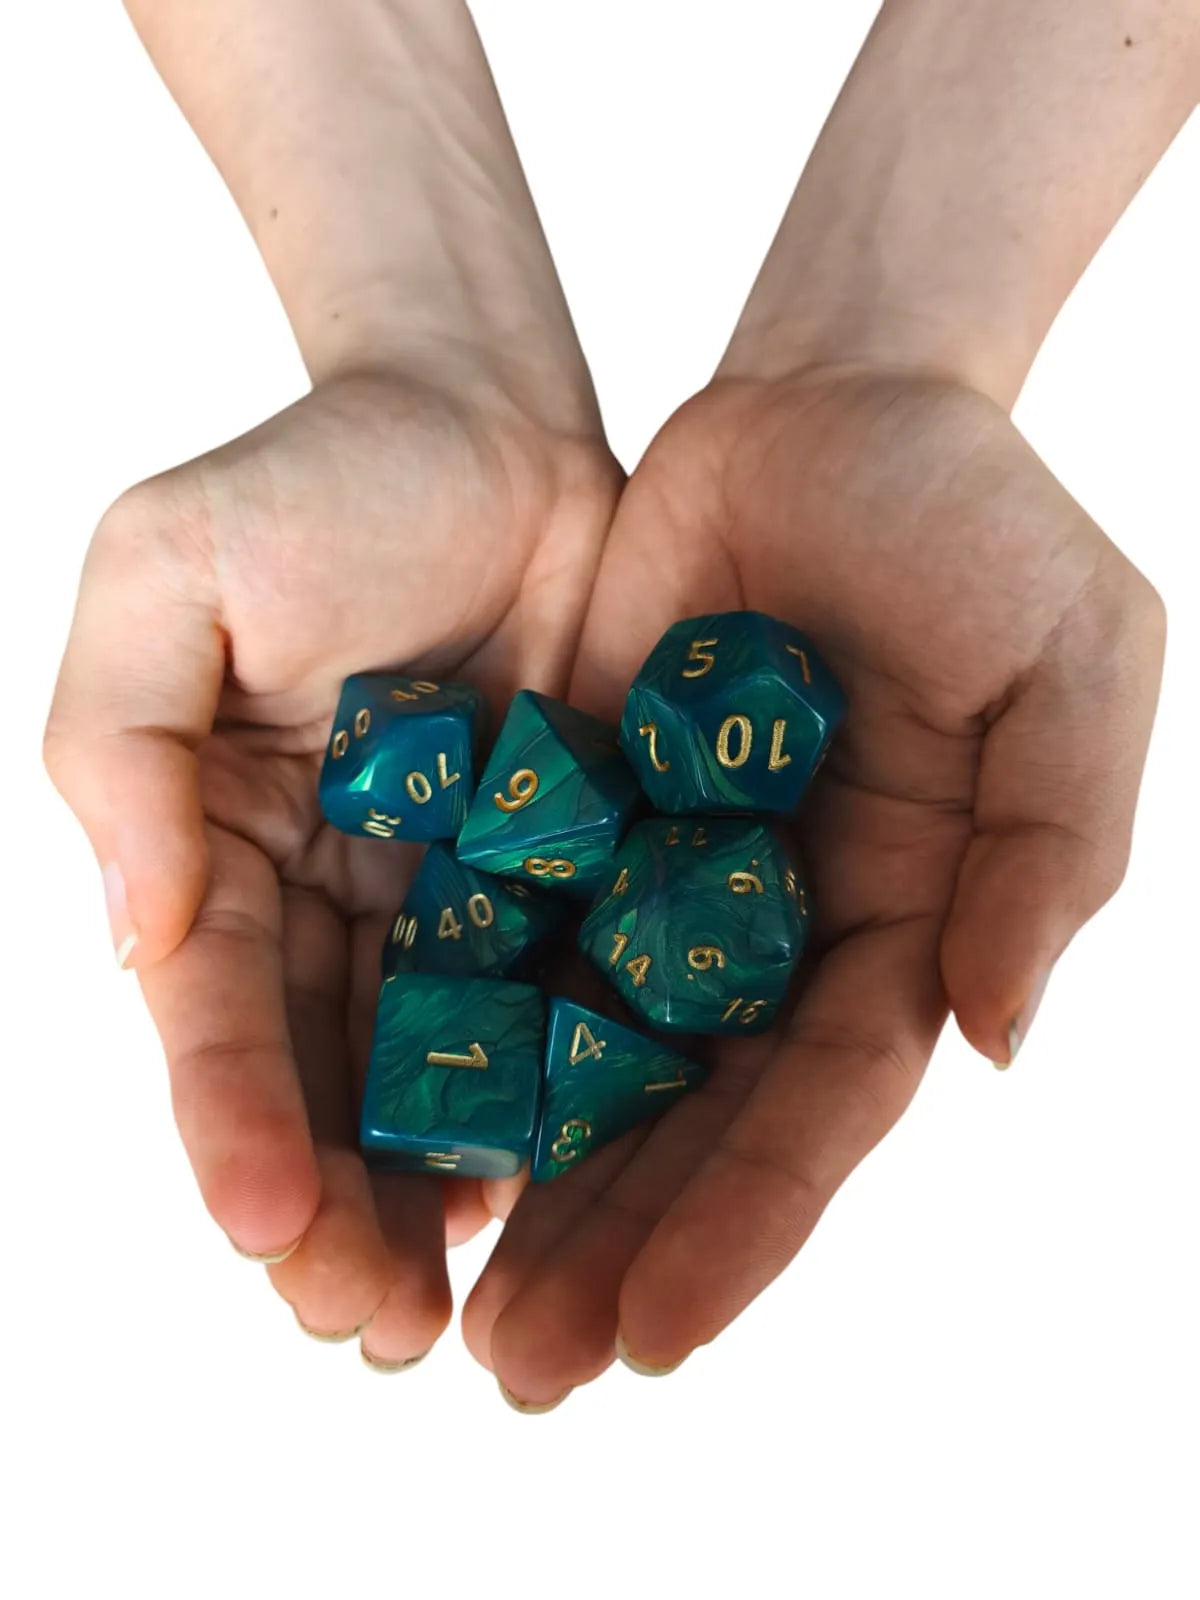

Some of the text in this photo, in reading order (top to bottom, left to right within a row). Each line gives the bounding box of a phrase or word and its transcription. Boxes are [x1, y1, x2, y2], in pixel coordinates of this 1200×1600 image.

[681, 637, 719, 678] 5
[716, 714, 792, 773] 10
[406, 752, 461, 804] 70
[524, 857, 577, 878] 8
[437, 893, 494, 940] 40
[608, 933, 652, 986] 14
[427, 1042, 489, 1070] 1
[569, 1022, 607, 1066] 4
[551, 1118, 591, 1162] 3
